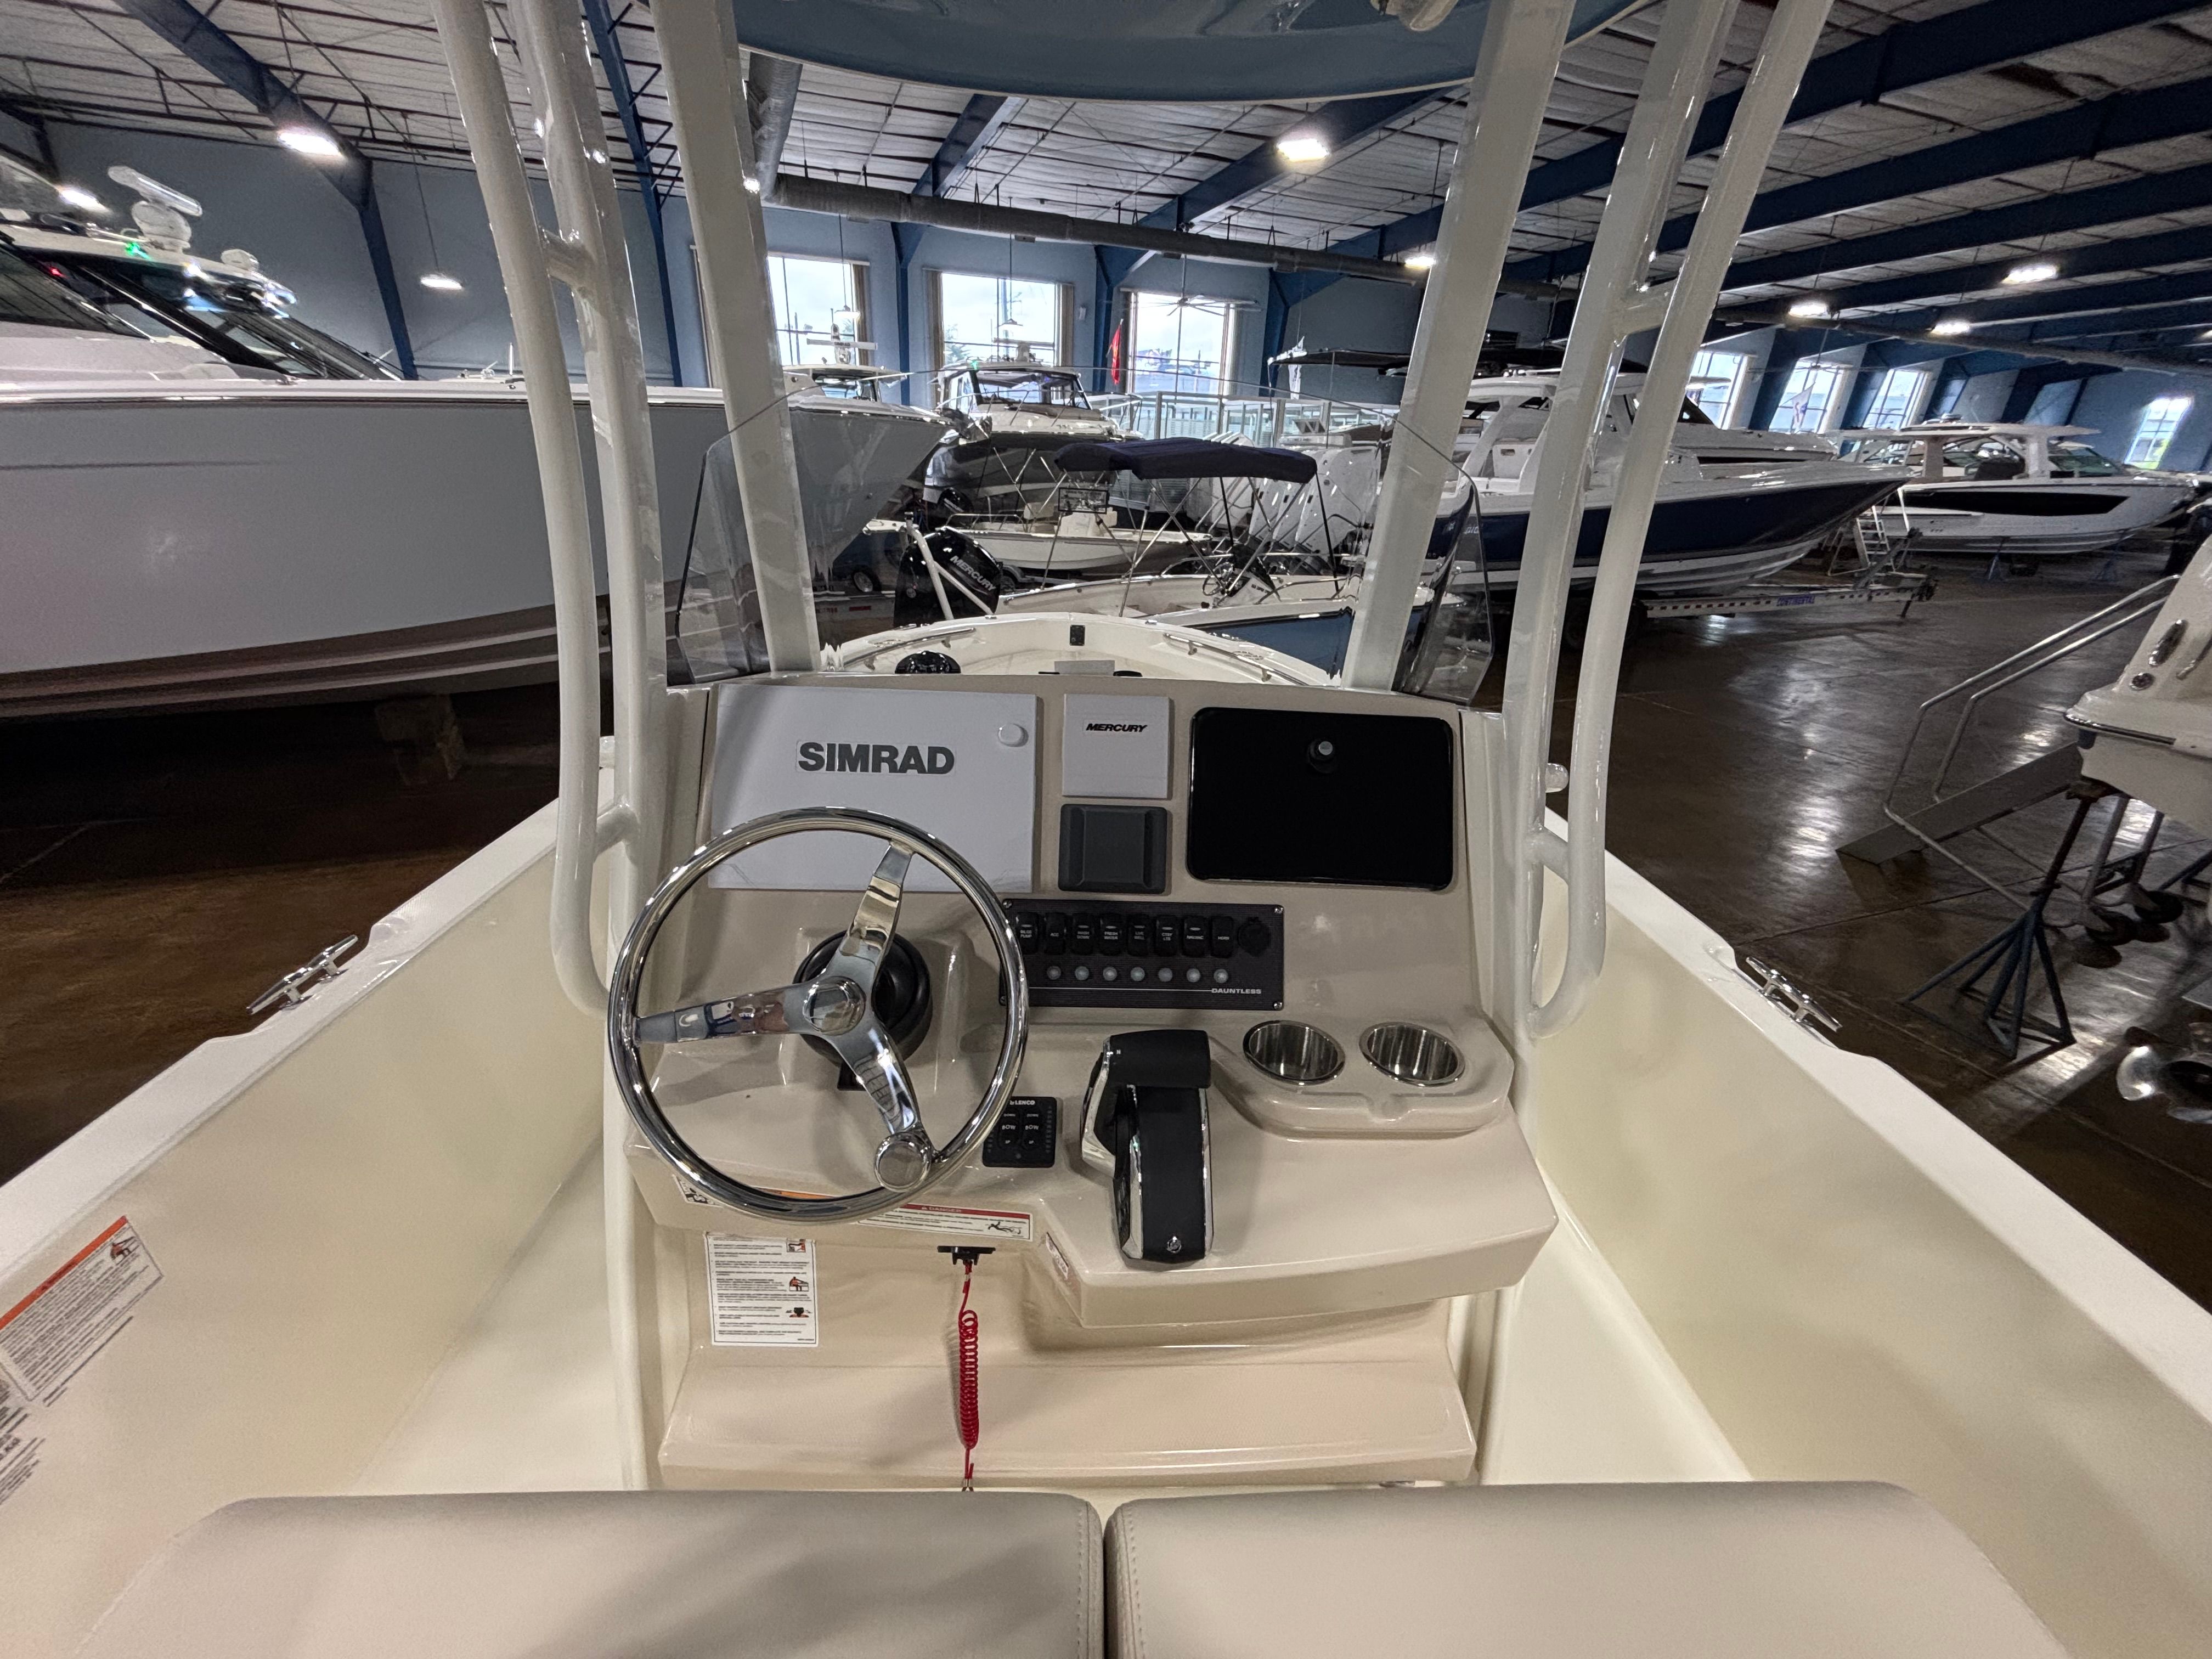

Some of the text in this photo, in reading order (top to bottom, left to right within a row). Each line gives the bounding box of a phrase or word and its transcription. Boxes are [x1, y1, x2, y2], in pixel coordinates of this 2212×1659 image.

[950, 555, 996, 591] MERCURY
[1086, 723, 1148, 732] MERCURY
[798, 742, 955, 775] SIMRAD
